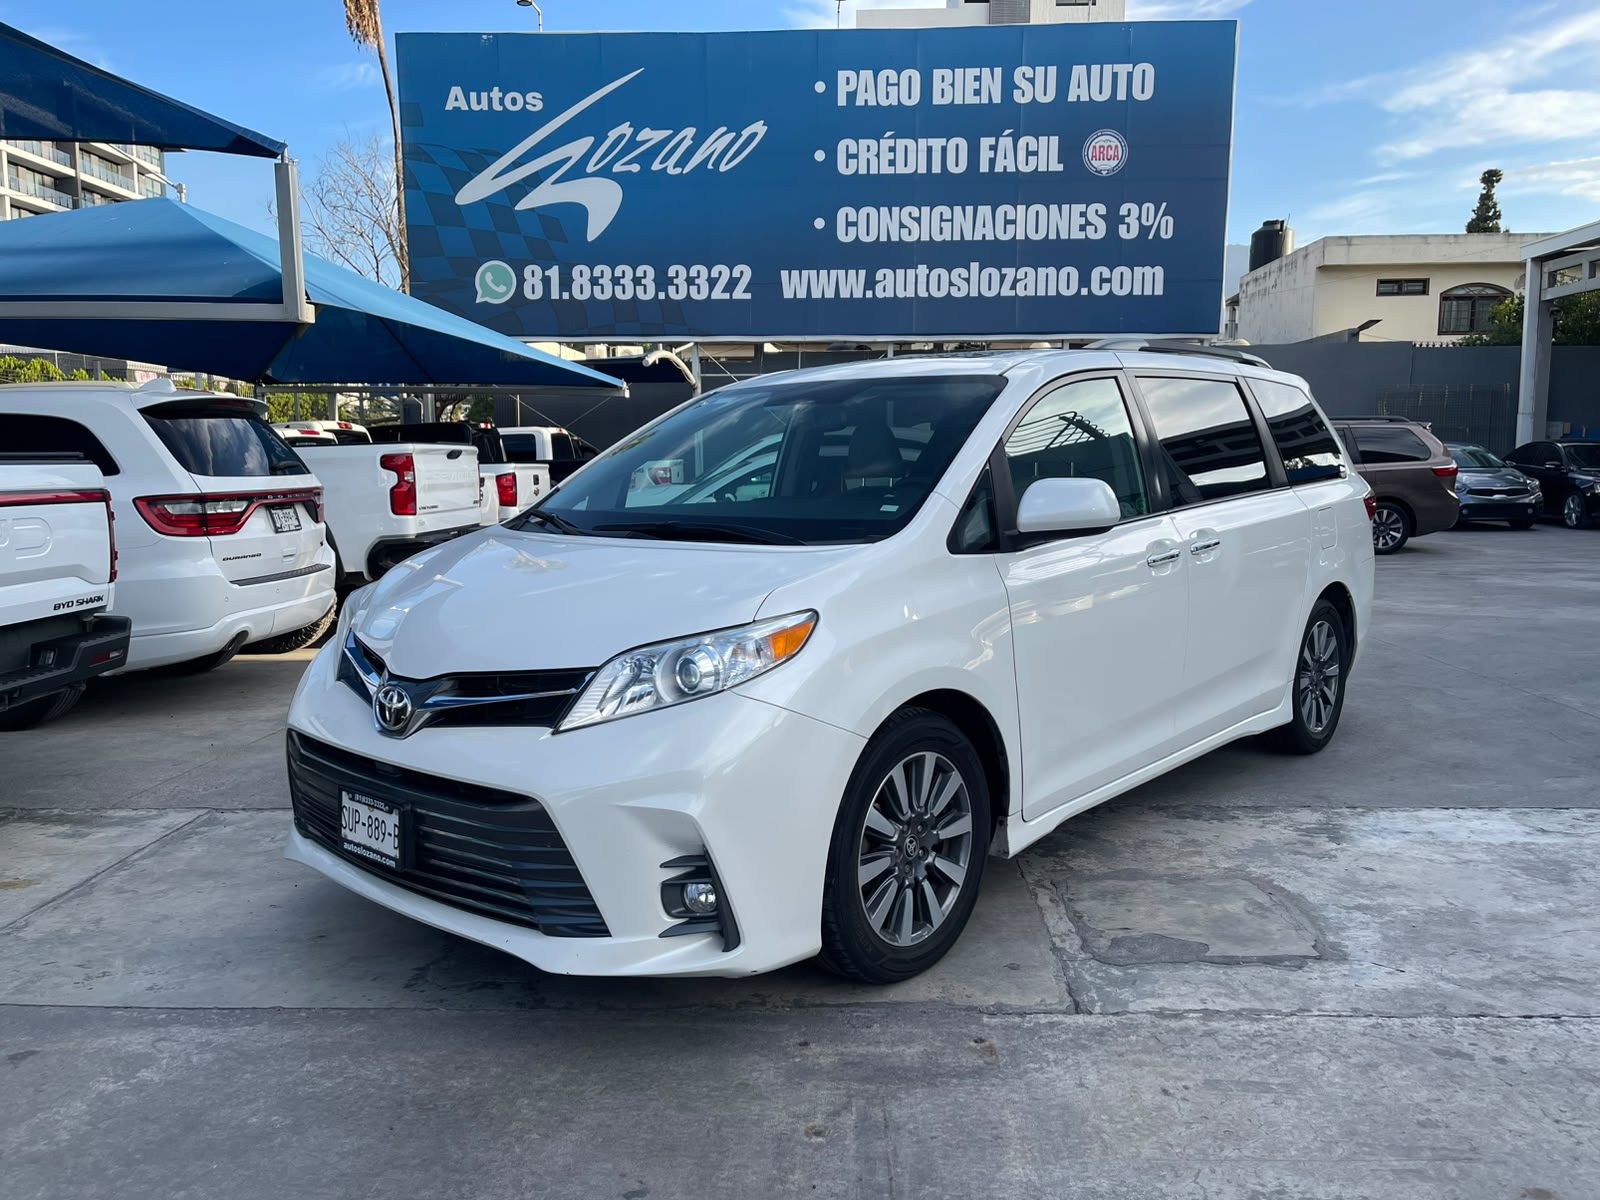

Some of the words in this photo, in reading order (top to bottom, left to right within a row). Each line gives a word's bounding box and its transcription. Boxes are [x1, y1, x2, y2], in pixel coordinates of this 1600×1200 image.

[444, 86, 544, 112] Autos
[837, 69, 921, 107] PAGO
[932, 67, 1001, 105] BIEN
[1013, 65, 1057, 103] SU
[1067, 63, 1155, 102] AUTO
[454, 67, 768, 242] Lozano
[836, 131, 968, 175] CRÉDITO
[979, 129, 1064, 173] FÁCIL
[1091, 144, 1120, 161] ARCA
[836, 203, 1107, 242] CONSIGNACIONES
[1118, 202, 1175, 240] 3%
[523, 264, 752, 300] 81.8333.3322
[780, 262, 1165, 299] www.autoslozano.com
[53, 600, 74, 611] BYD
[75, 594, 105, 606] SHARK
